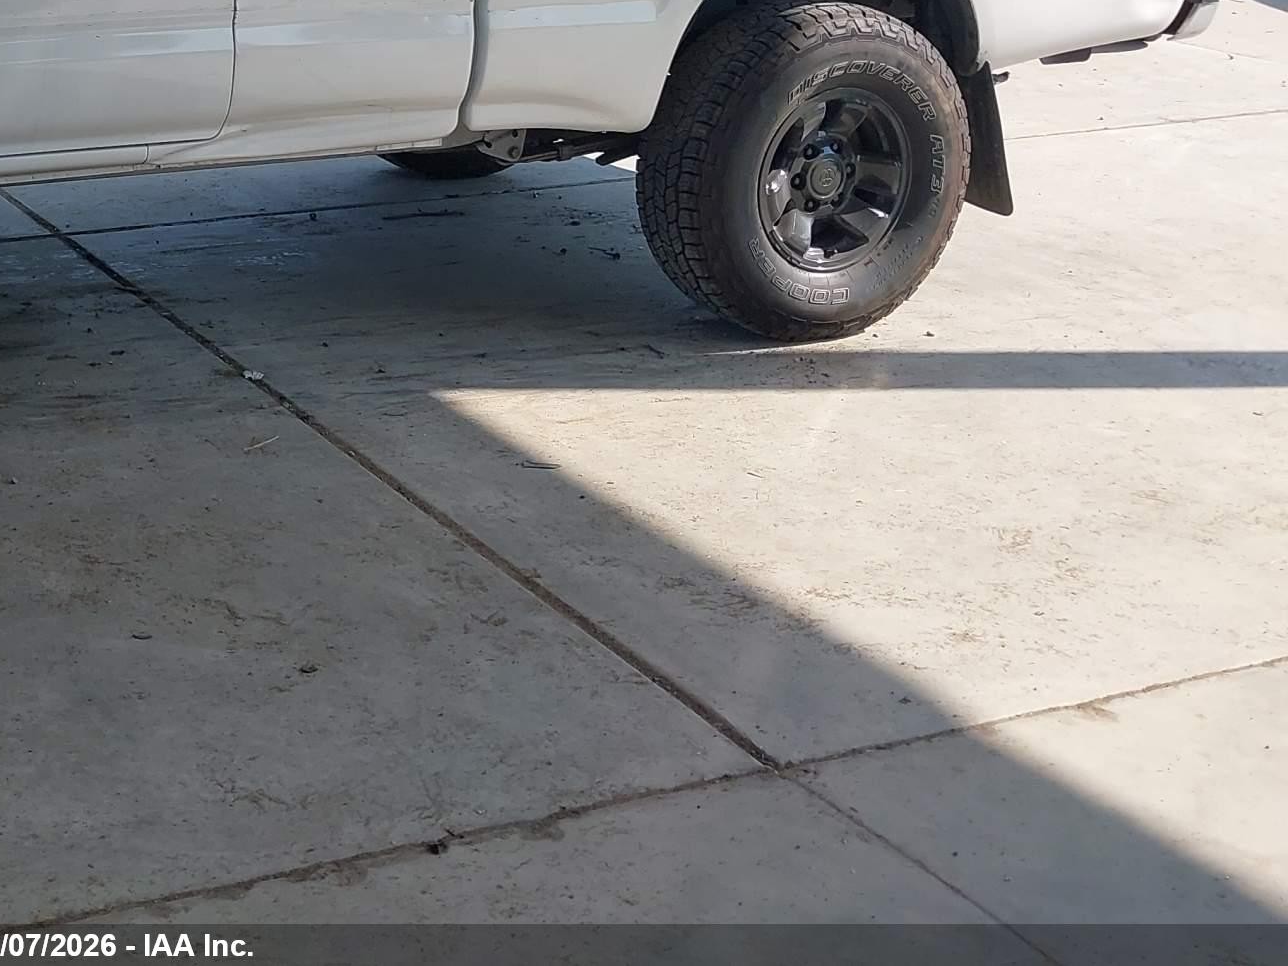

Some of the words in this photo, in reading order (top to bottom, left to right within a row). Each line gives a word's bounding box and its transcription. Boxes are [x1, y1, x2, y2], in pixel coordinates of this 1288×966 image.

[788, 59, 937, 122] DISCOVERER
[929, 134, 946, 194] AT3
[748, 236, 849, 306] COOPER
